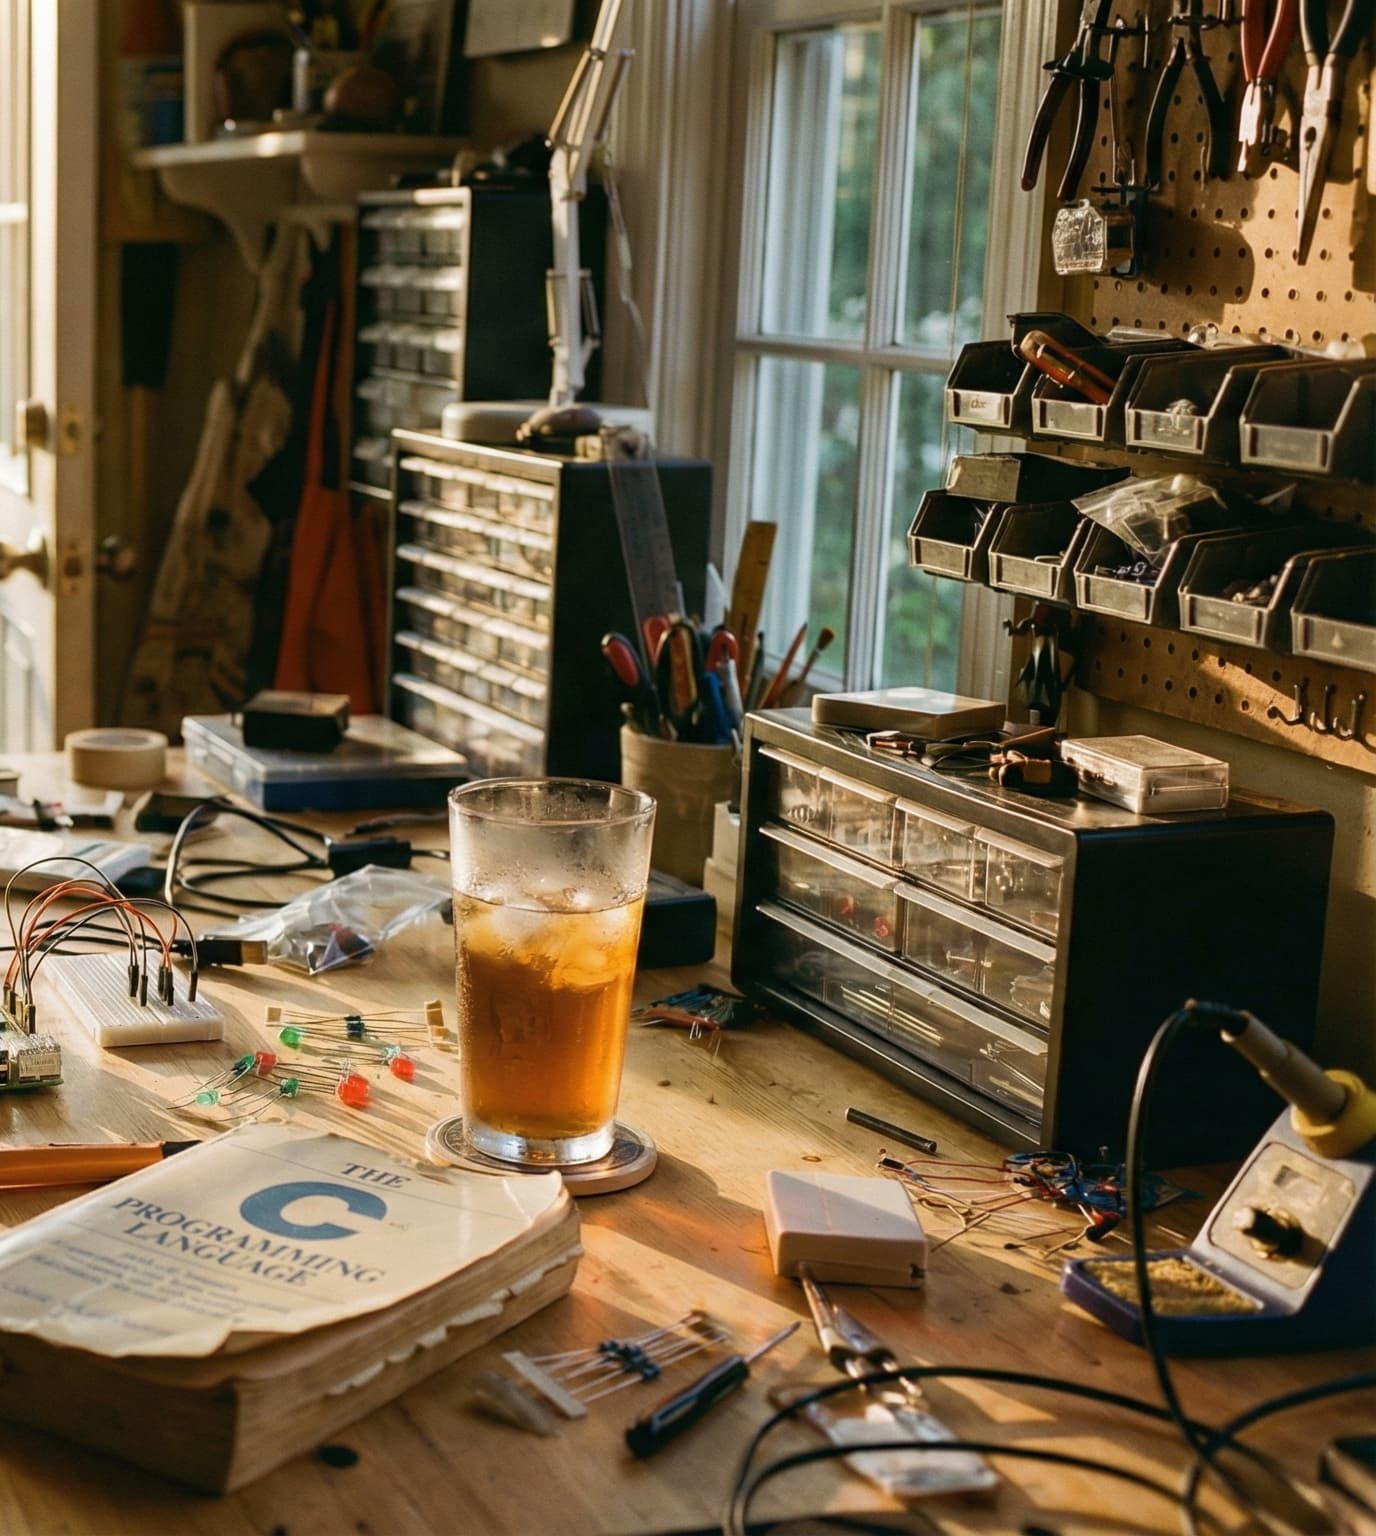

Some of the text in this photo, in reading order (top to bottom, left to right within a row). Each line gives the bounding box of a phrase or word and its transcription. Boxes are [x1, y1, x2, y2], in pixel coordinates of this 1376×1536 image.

[341, 1163, 411, 1189] THE
[112, 1197, 385, 1283] PROGRAMMING
[240, 1181, 388, 1241] C
[124, 1221, 317, 1285] LANGUAGE
